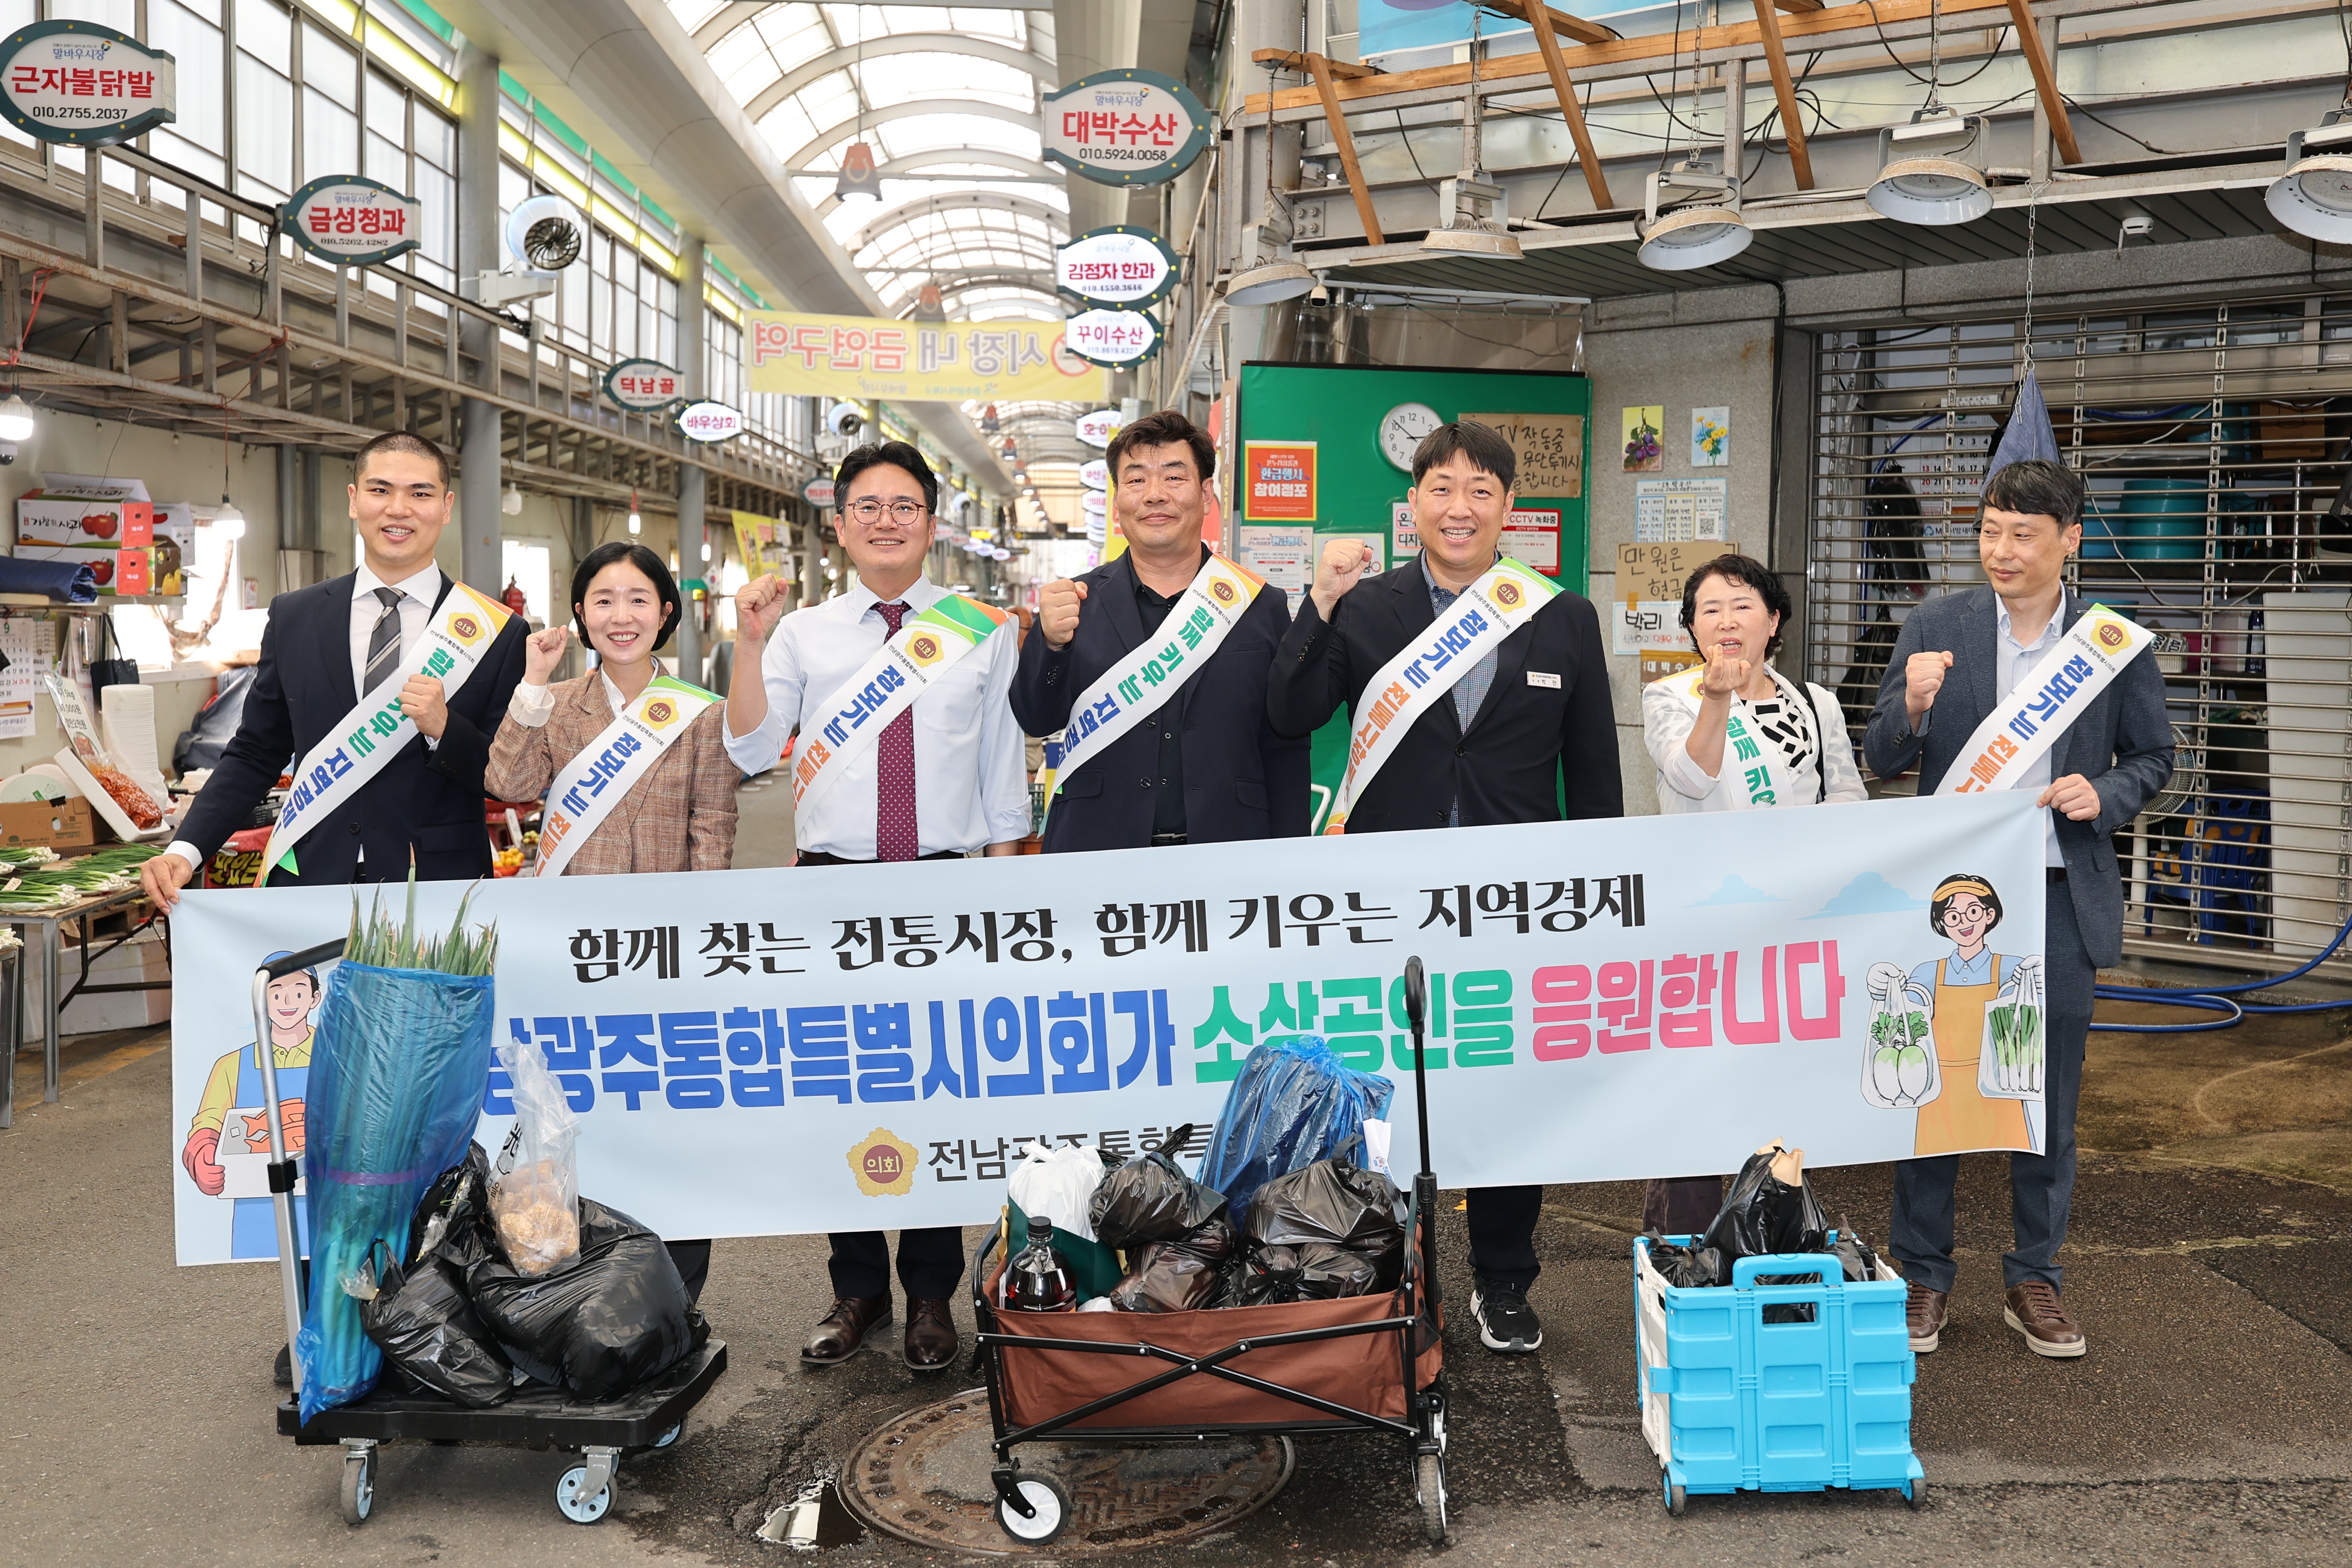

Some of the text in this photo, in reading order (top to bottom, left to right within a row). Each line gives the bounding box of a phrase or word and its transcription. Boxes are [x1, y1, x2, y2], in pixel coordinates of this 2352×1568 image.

[53, 48, 105, 60] 말바우시장
[11, 66, 155, 98] 근자불닭발
[1095, 95, 1143, 106] 말바우시장
[33, 107, 127, 119] 010.2755.2037
[1063, 111, 1178, 145] 대박수산
[1079, 148, 1167, 160] 010.5924.0058
[335, 195, 373, 204] 말바우시장
[309, 206, 405, 235] 금성청과
[321, 237, 388, 246] 010.5262.4282
[1068, 262, 1155, 279] 김점자 한과
[1077, 325, 1143, 345] 꾸이수산
[687, 415, 736, 430] 바우상회
[1408, 413, 1416, 421] 12
[1521, 426, 1564, 452] 작동중
[1260, 467, 1304, 481] 환급행사
[1254, 482, 1308, 497] 참여점포
[1509, 515, 1534, 523] CCTV
[1535, 515, 1556, 524] 녹화중
[1271, 536, 1302, 546] 환급행사
[1398, 533, 1423, 546] 디지
[1214, 583, 1232, 600] 의회
[1497, 585, 1517, 604] 의회
[1192, 588, 1232, 626] 전남광주통합특별시의회
[1470, 588, 1511, 631] 전남광주통합특별시의회
[4, 622, 10, 634] 9
[454, 620, 476, 637] 의회
[1177, 605, 1215, 652] 함께
[1625, 610, 1662, 630] 박리
[430, 629, 475, 664] 전남광주통합특별시의회
[2100, 627, 2122, 646] 의회
[915, 639, 935, 659] 의회
[1403, 609, 1489, 689] 장보기는
[2073, 632, 2116, 674] 전남광주통합특별시의회
[888, 644, 928, 684] 전남광주통합특별시의회
[1117, 641, 1185, 706] 키우는
[823, 664, 906, 748] 장보기는
[2009, 653, 2094, 741] 장보기는
[649, 706, 670, 721] 의회
[622, 714, 665, 747] 전남광주통합특별시의회
[1726, 716, 1761, 762] 함께
[561, 731, 642, 818] 장보기는
[568, 873, 1646, 983] 함께 찾는 전통시장, 함께 키우는 지역경제
[1531, 938, 1847, 1063] 응원합니다
[866, 1154, 902, 1174] 의회
